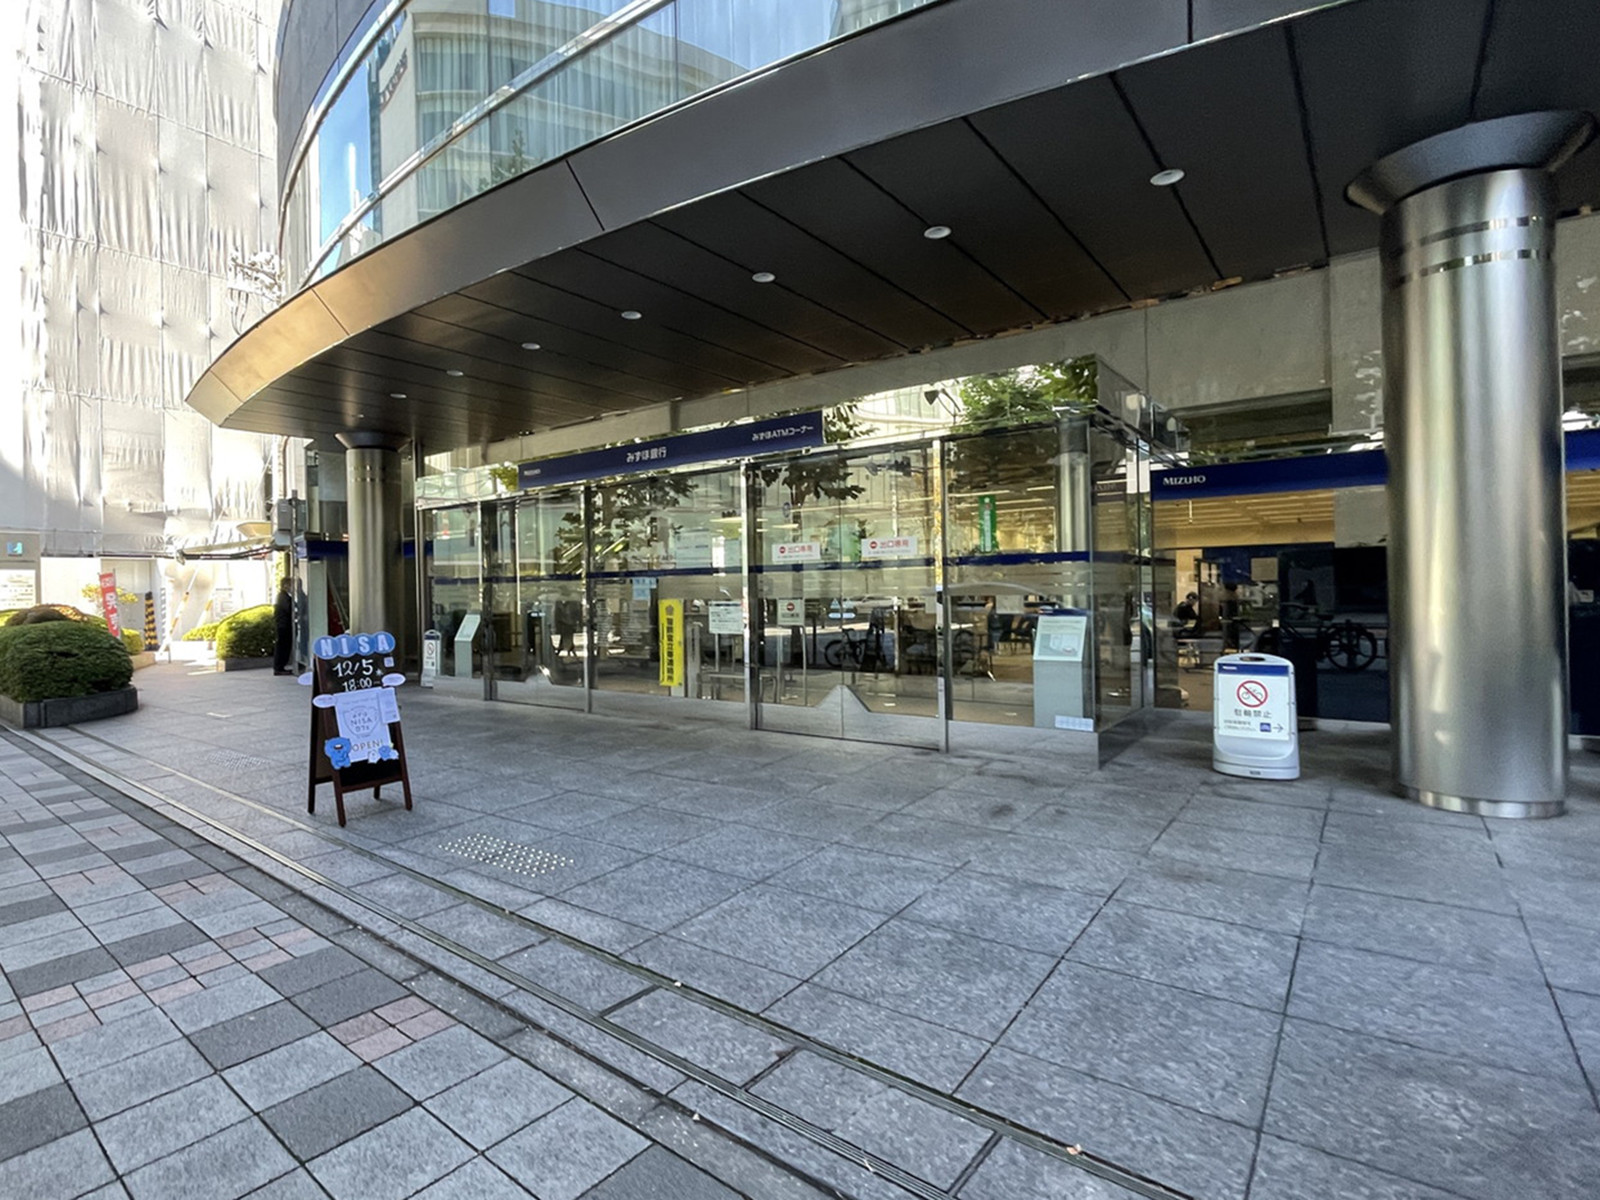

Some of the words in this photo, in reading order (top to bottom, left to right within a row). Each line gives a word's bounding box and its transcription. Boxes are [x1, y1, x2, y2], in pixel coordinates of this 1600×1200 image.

[626, 446, 667, 463] みずほ銀行
[1162, 474, 1206, 486] MIZUHO
[320, 634, 389, 657] NISA
[332, 659, 374, 678] 12/5
